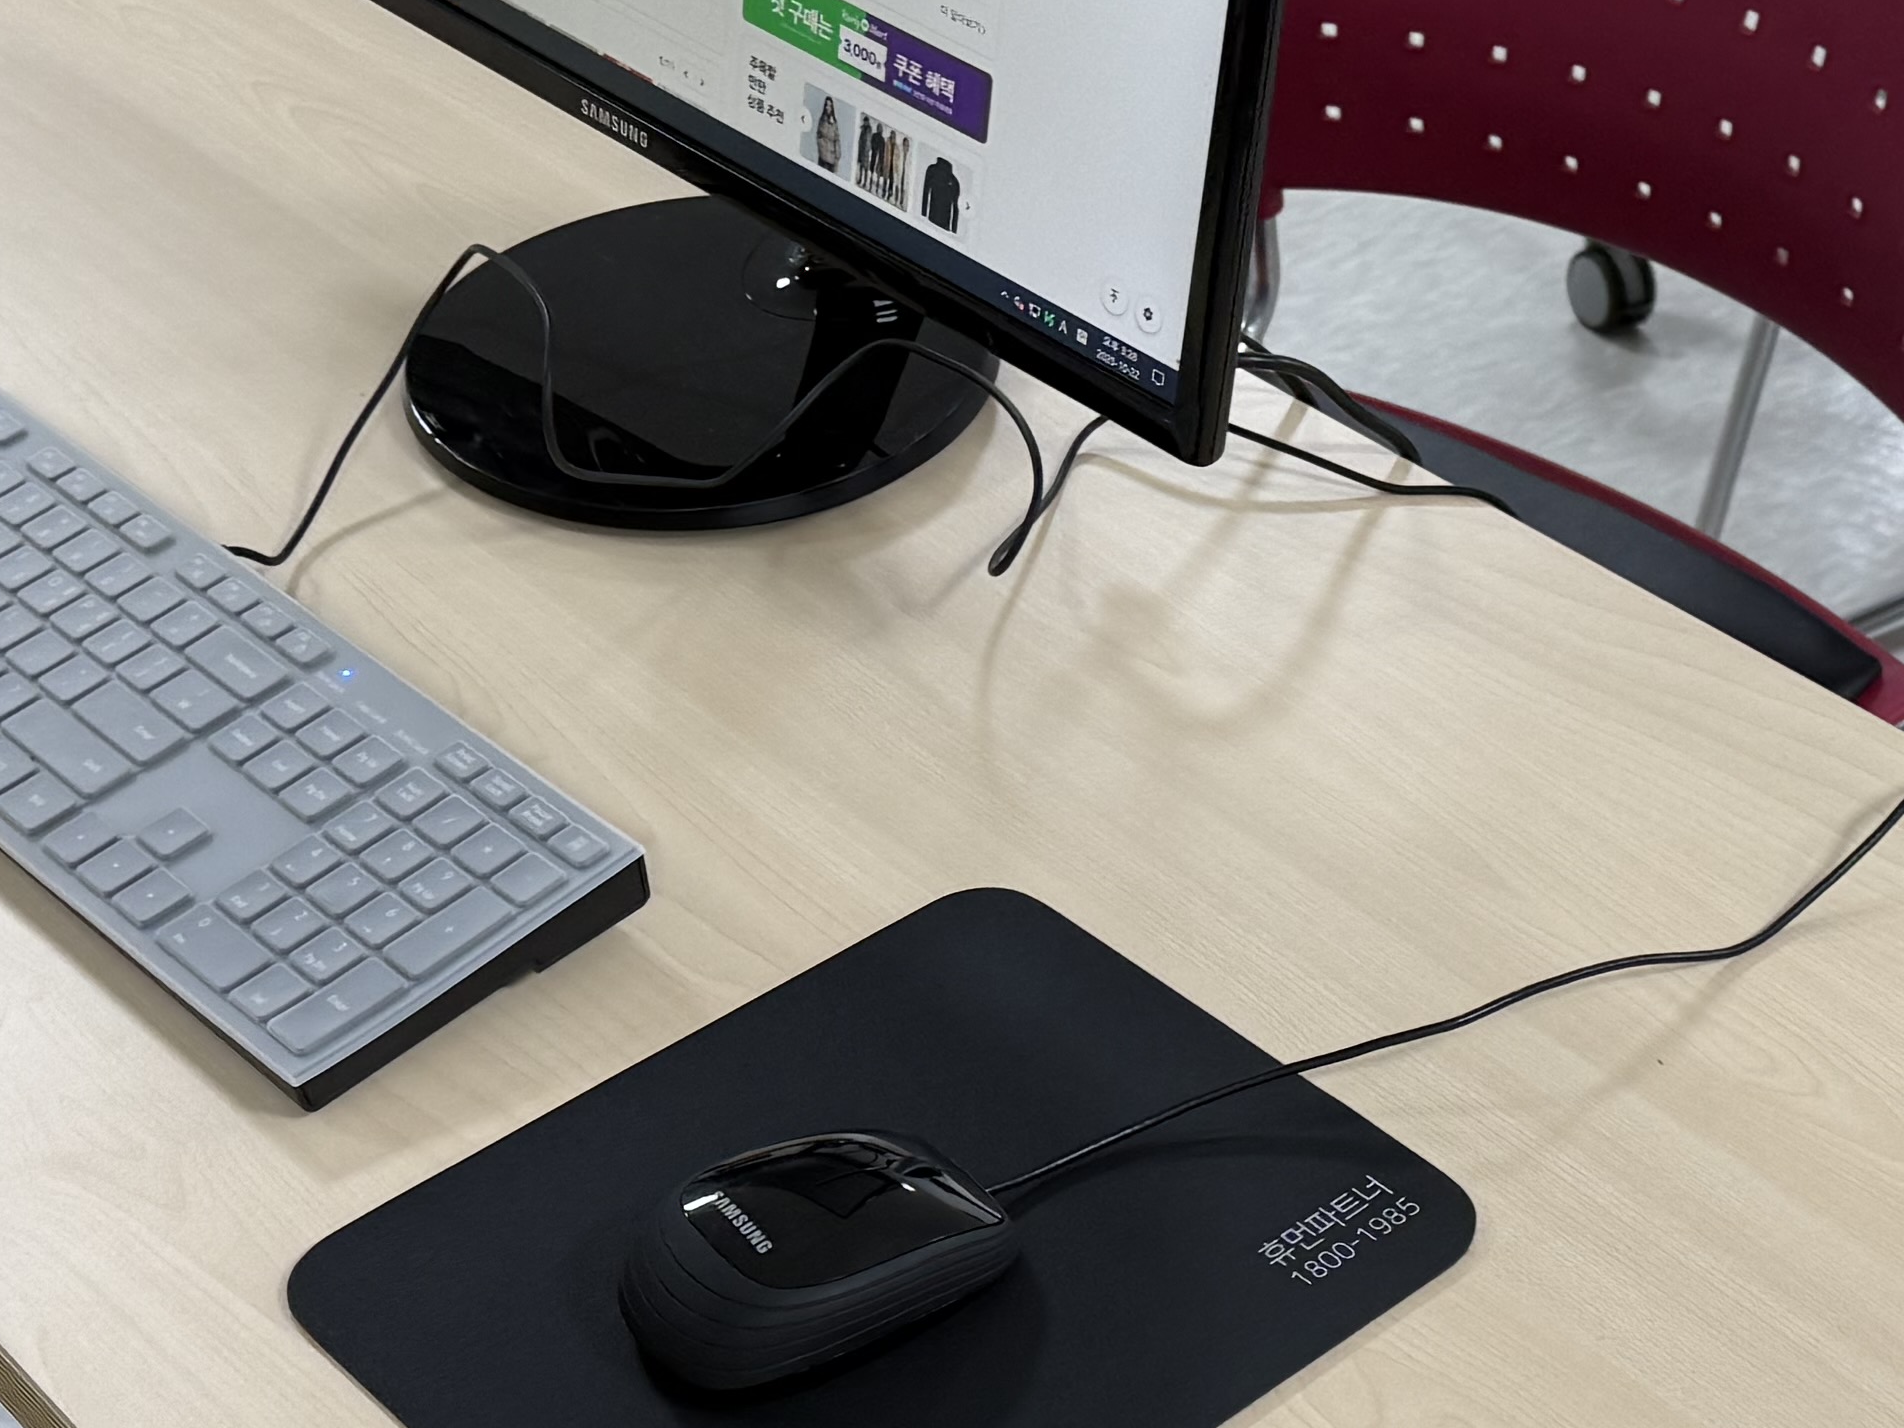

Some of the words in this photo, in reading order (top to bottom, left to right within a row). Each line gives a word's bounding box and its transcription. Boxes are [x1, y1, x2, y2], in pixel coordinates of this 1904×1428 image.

[892, 50, 923, 88] 쿠폰
[924, 66, 955, 105] 혜택
[579, 97, 650, 150] SAMSUNG
[708, 1188, 774, 1257] SAMSUNG
[1256, 1174, 1394, 1267] 휴먼파트너
[1290, 1199, 1421, 1285] 1800-1985
